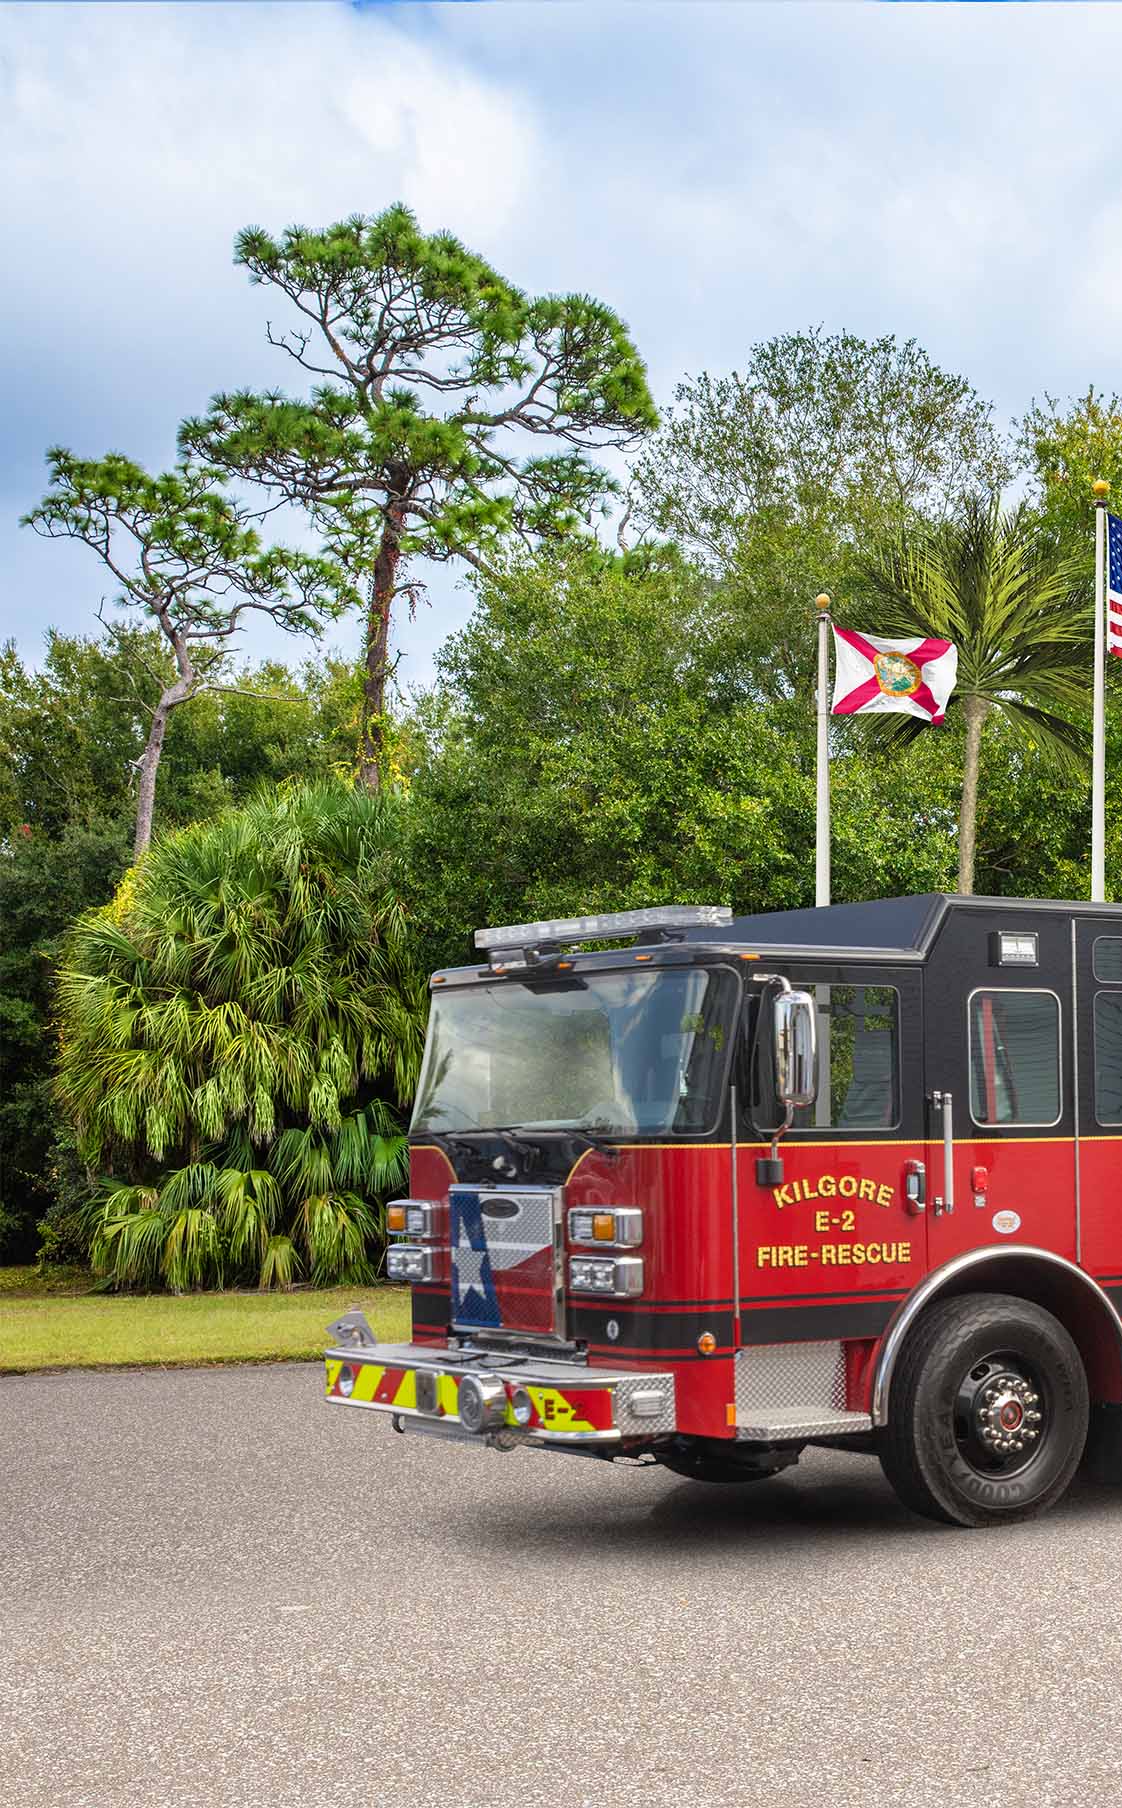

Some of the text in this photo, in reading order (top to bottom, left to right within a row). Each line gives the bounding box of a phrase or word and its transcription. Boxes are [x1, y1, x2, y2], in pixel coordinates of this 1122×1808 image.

[772, 1175, 894, 1208] KILGORE
[815, 1210, 855, 1232] E-2
[757, 1242, 911, 1268] FIRE-RESCUE
